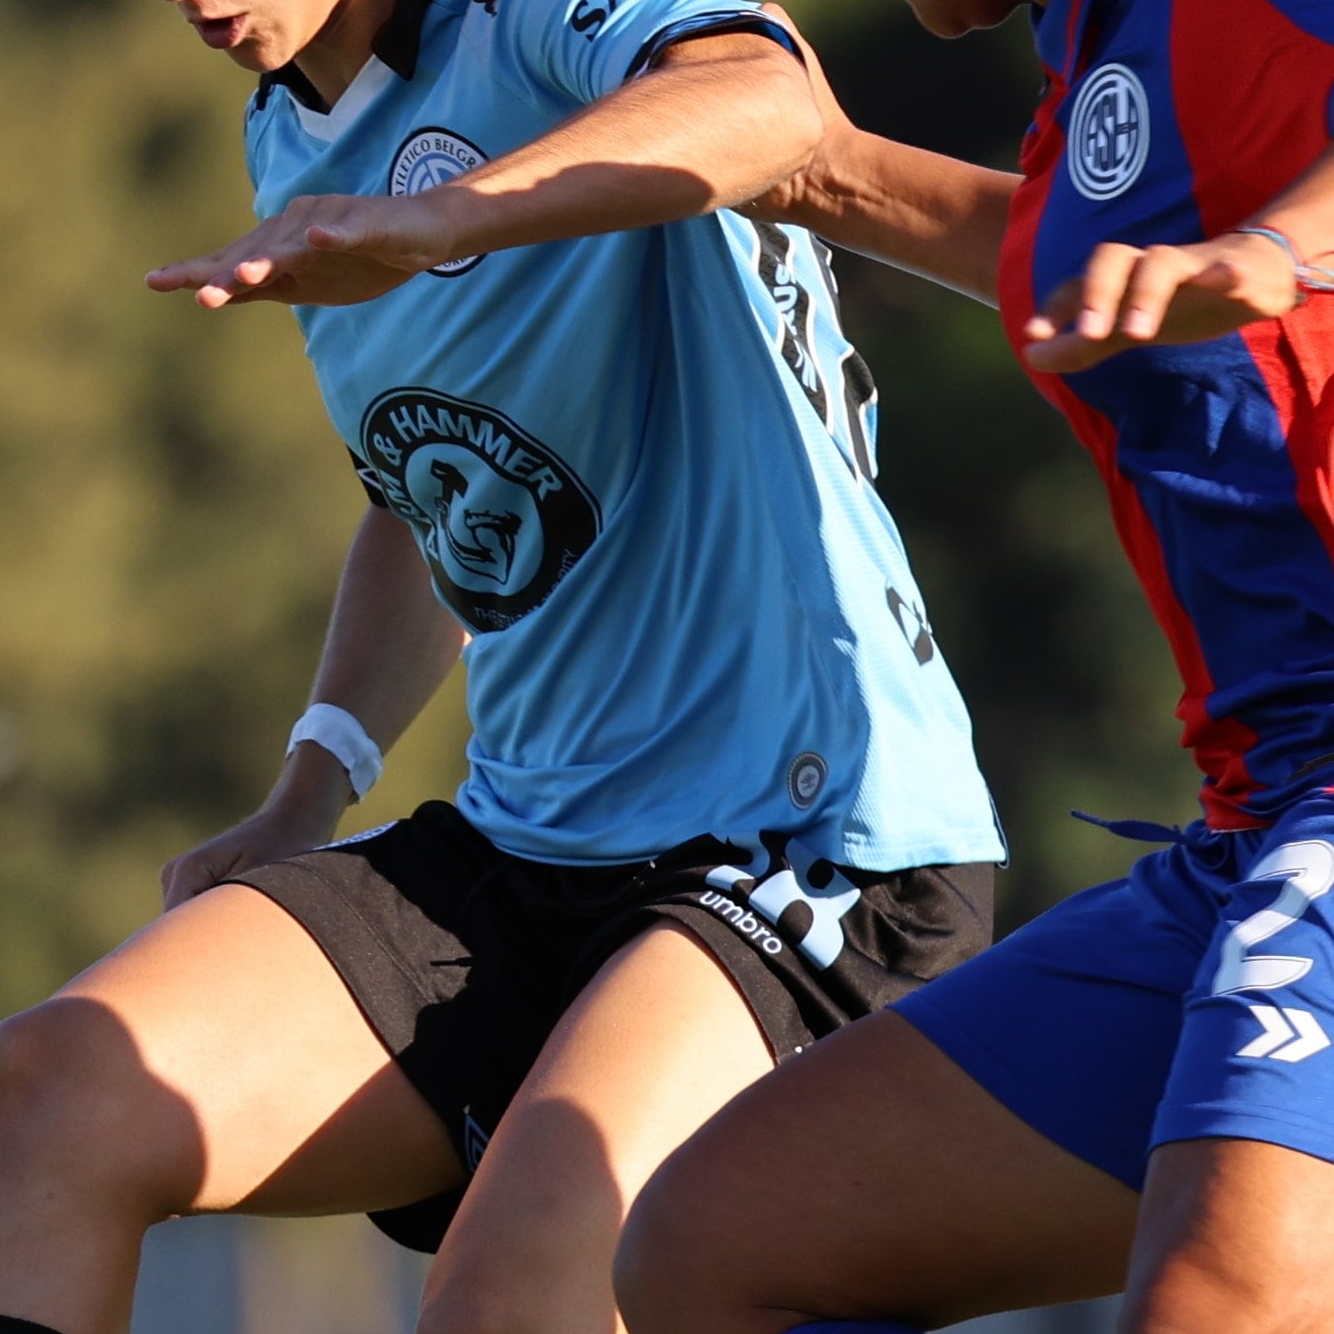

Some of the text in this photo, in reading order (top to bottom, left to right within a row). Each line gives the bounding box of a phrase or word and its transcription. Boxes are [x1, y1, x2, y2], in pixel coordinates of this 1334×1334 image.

[434, 138, 477, 169] BELGR
[388, 404, 564, 502] HAMMER
[698, 889, 783, 955] umbro
